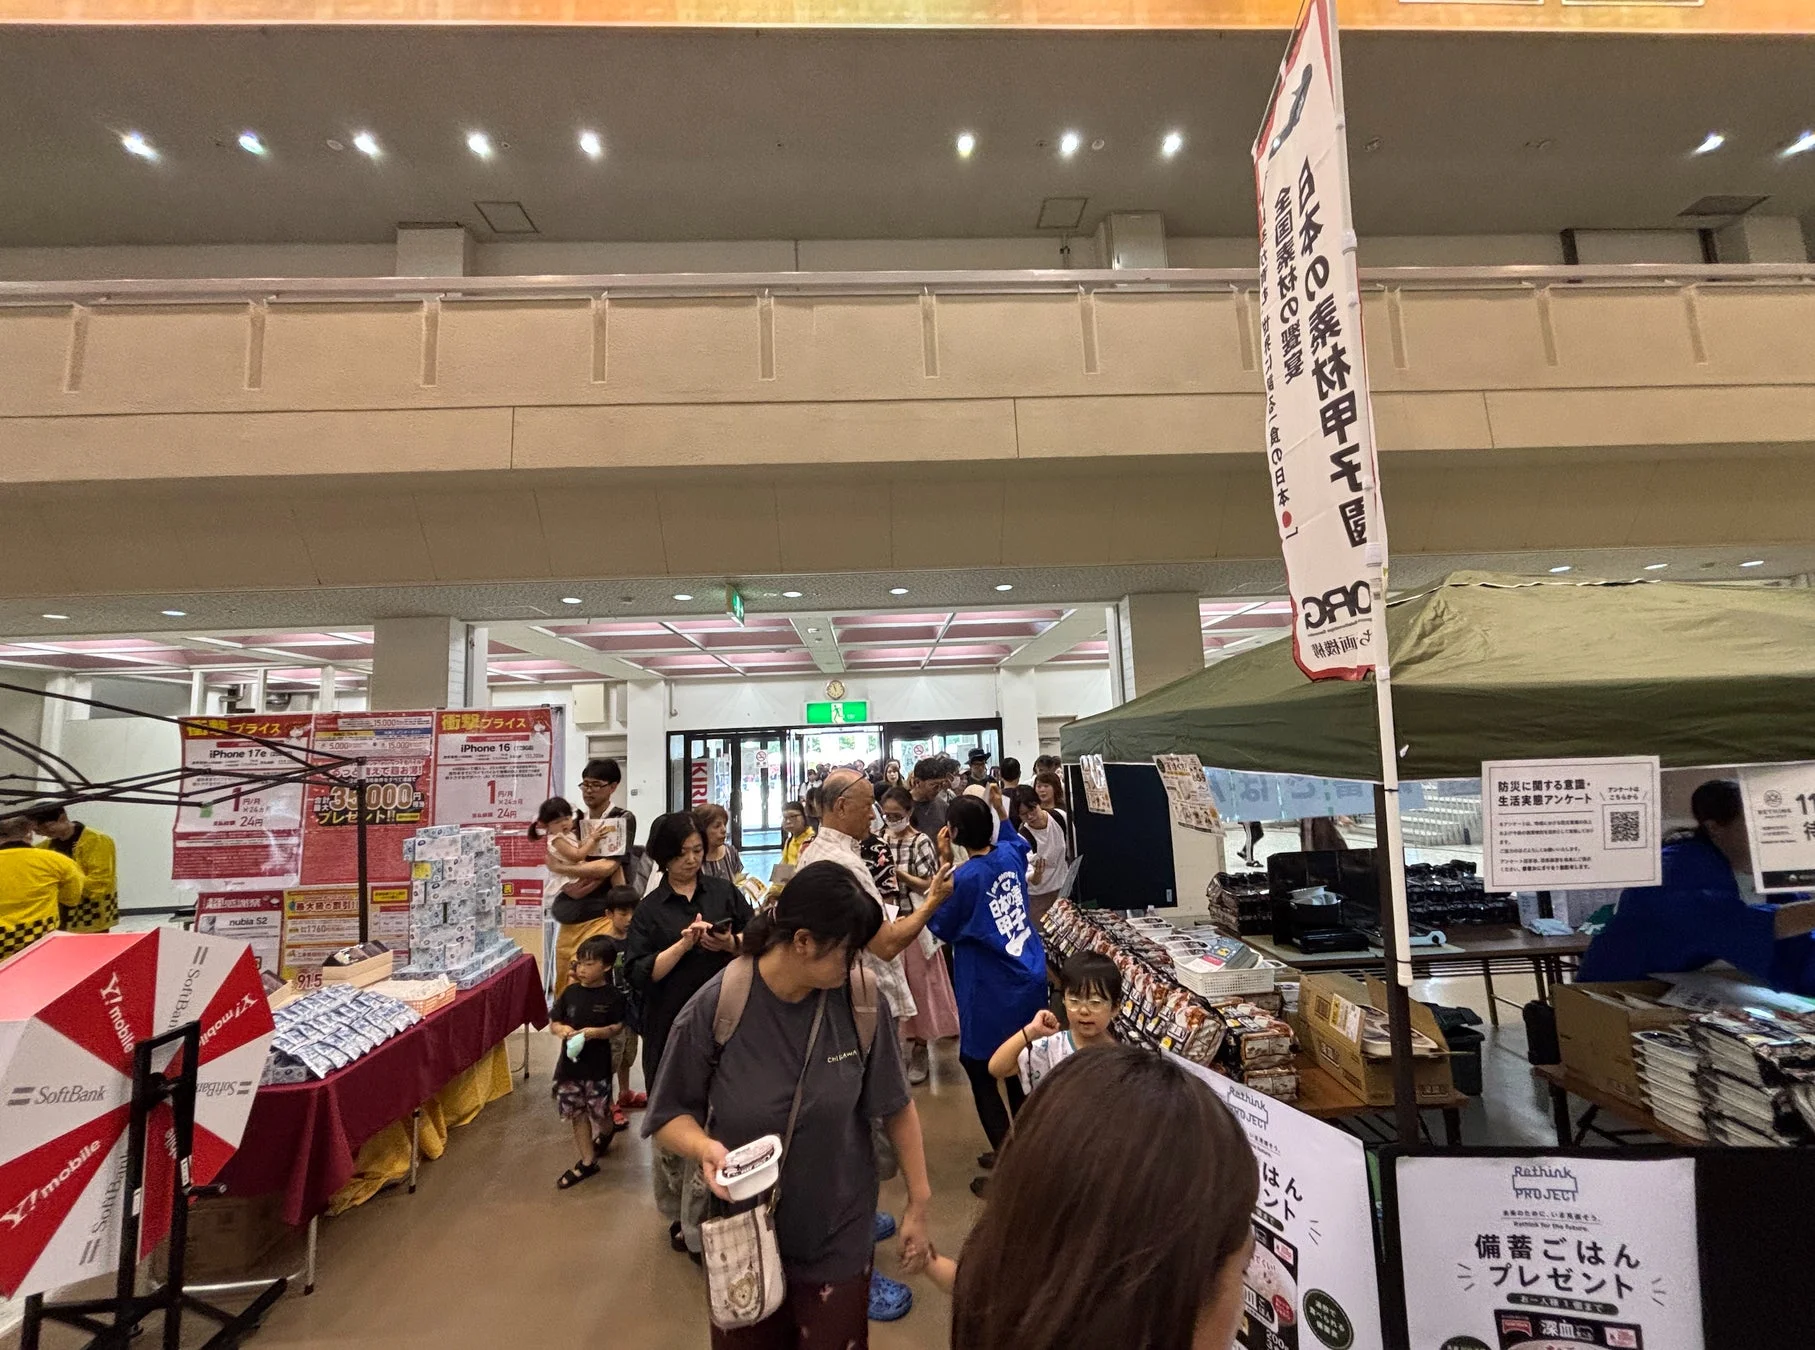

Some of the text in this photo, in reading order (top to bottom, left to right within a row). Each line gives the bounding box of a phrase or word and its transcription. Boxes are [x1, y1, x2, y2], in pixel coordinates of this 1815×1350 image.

[441, 713, 526, 732] 衝撃プライス
[209, 750, 245, 759] iPhone
[248, 749, 267, 758] 17e
[460, 743, 496, 753] iPhone
[499, 743, 511, 752] 16
[329, 782, 413, 811] 35000
[1498, 778, 1591, 793] 防災に関する意識・
[1498, 793, 1593, 807] 生活実態アンケート
[229, 916, 268, 926] nubia S2
[100, 971, 135, 1054] Y!mobile
[199, 992, 260, 1048] Y!mobil
[34, 1084, 106, 1106] SoftBank
[196, 1081, 236, 1096] SoftBan
[1229, 1086, 1267, 1110] Rethink
[1231, 1104, 1268, 1130] ROJECT
[1262, 1161, 1304, 1202] はん
[1514, 1166, 1572, 1178] Rethink
[0, 1138, 101, 1230] Y!mobile
[1515, 1189, 1578, 1202] PROJECT
[1475, 1233, 1640, 1270] 備蓄ごはん
[1489, 1264, 1634, 1300] プレゼント
